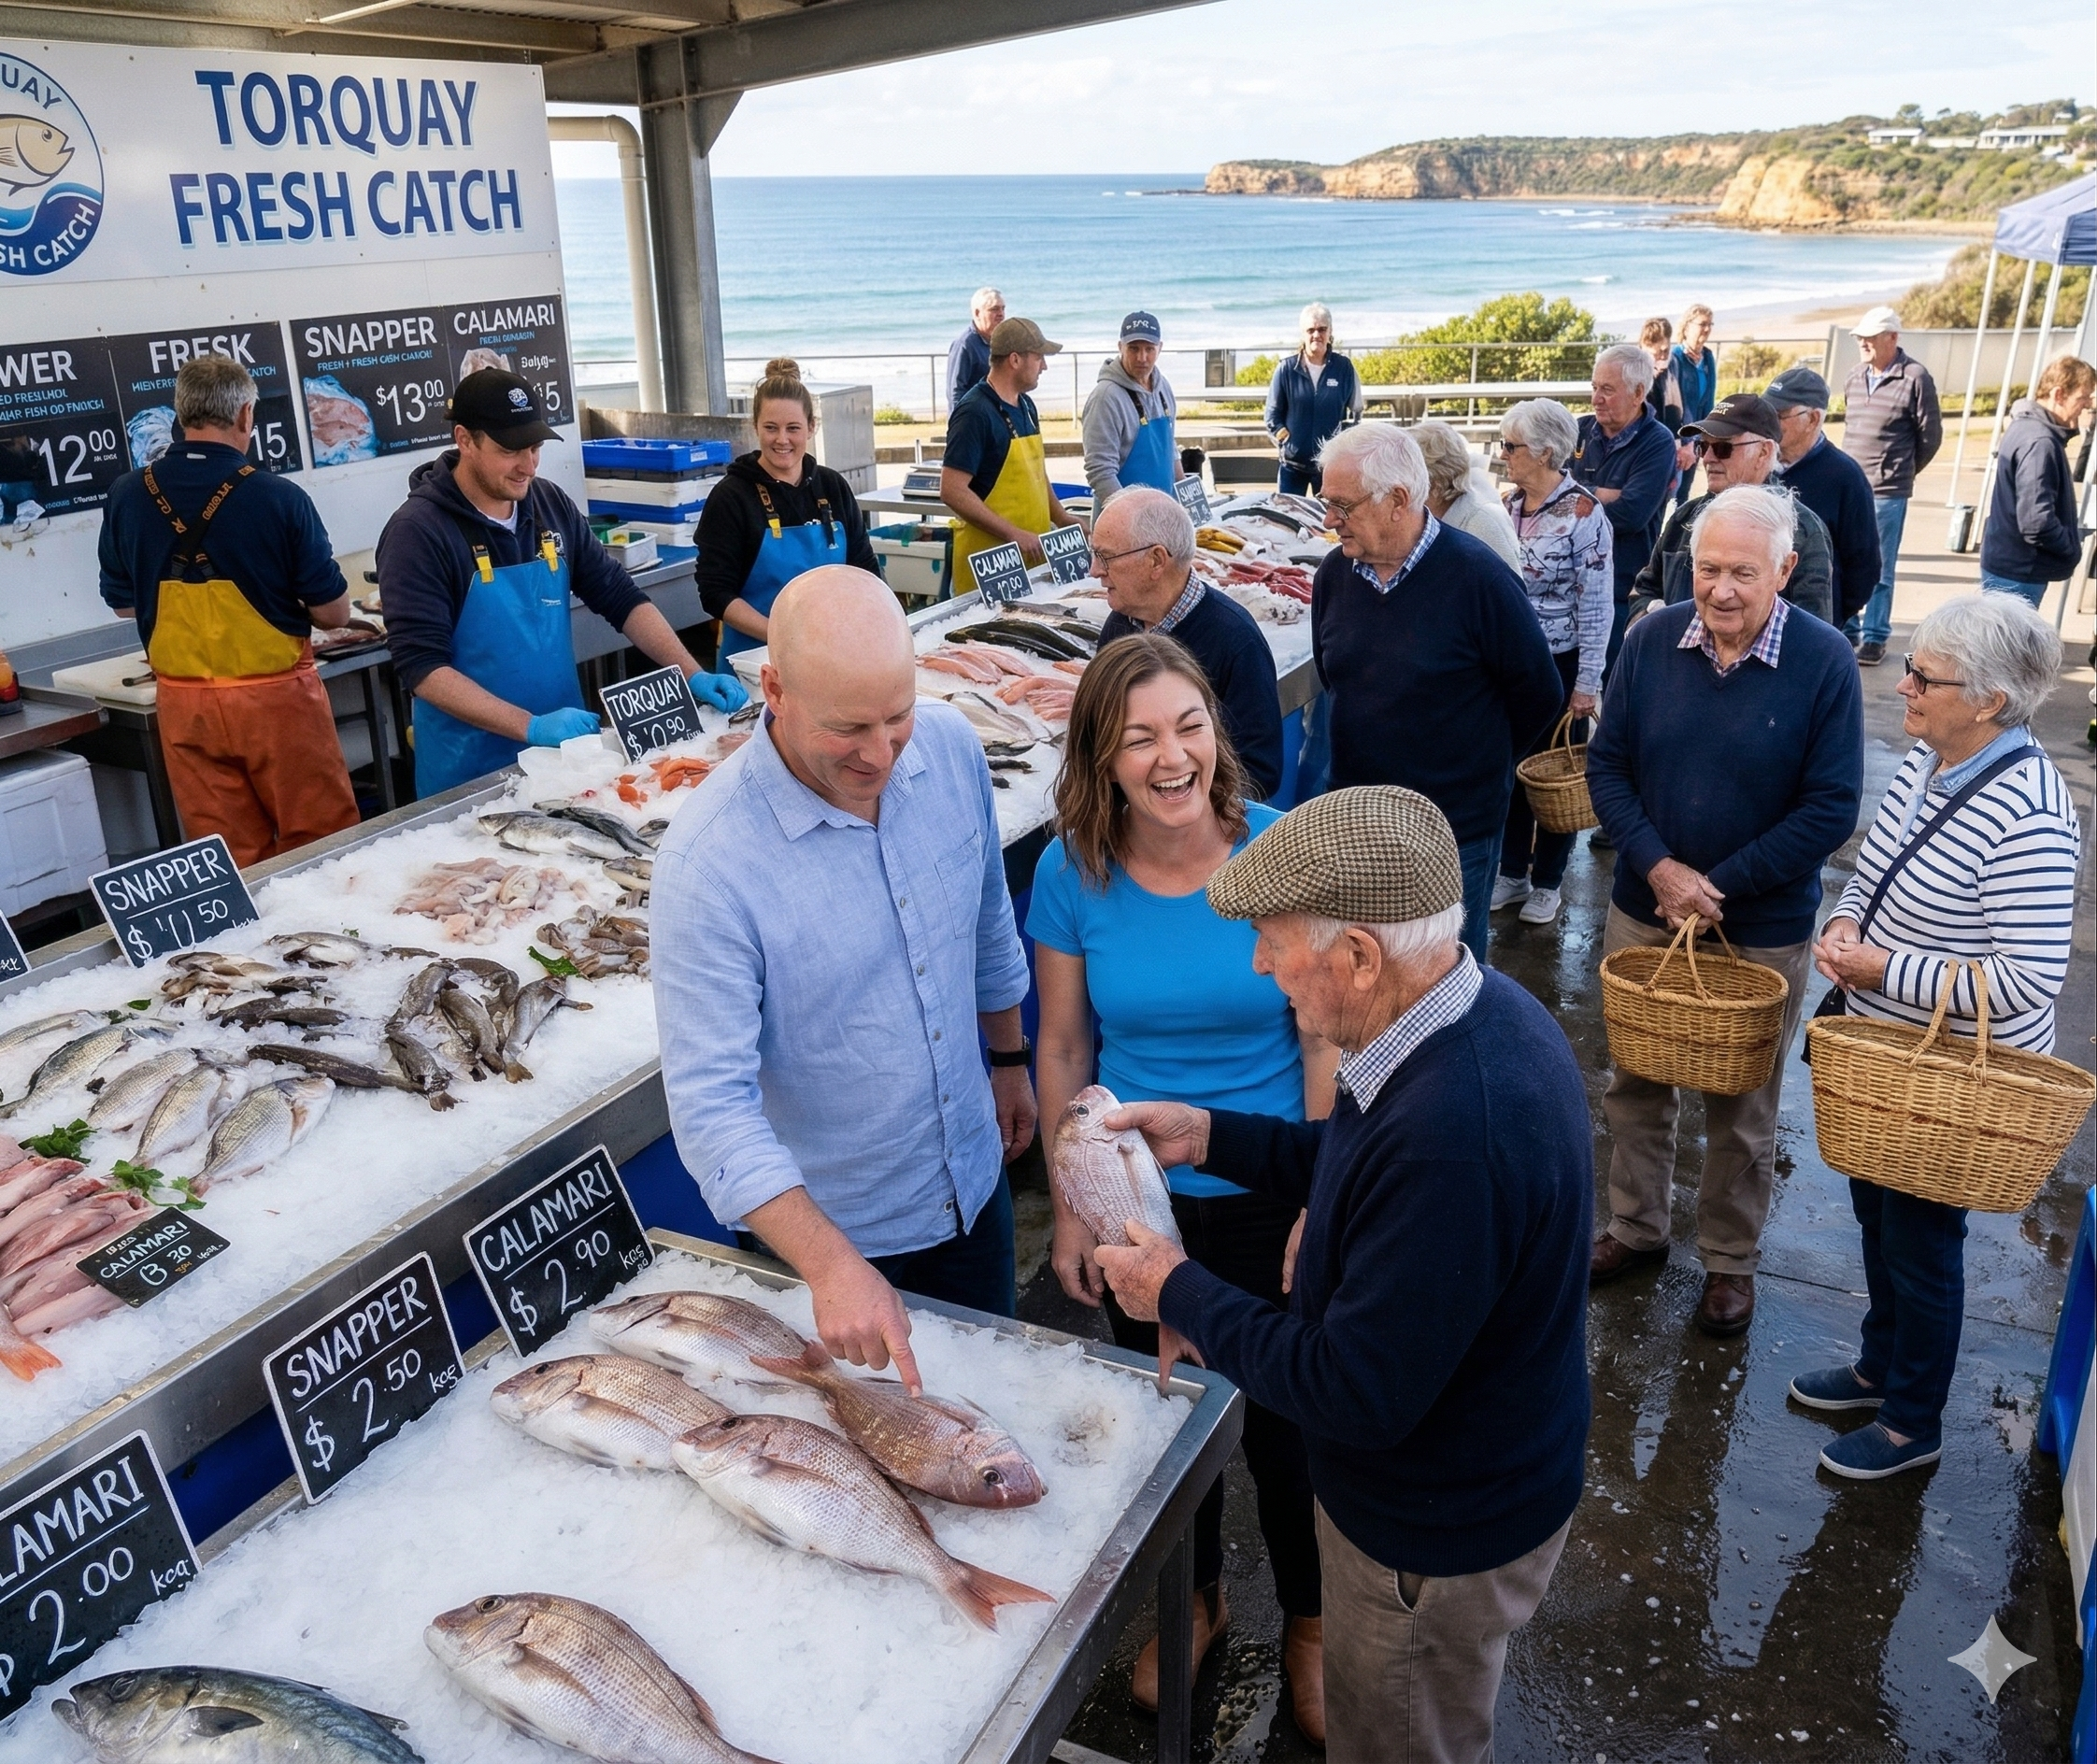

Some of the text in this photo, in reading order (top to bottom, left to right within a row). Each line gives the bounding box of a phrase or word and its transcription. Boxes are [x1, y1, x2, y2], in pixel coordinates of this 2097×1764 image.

[194, 70, 478, 154] TORQUAY
[33, 203, 95, 266] CATCH
[169, 169, 521, 245] FRESH CATCH
[305, 316, 438, 358] SNAPPER
[453, 303, 556, 335] CALAMARI
[606, 674, 683, 721] TORQUAY
[627, 731, 643, 760] $
[105, 847, 229, 911] SNAPPER
[127, 924, 153, 960] $
[480, 1161, 613, 1272] CALAMARI
[100, 1220, 188, 1279] CALAMARI
[286, 1276, 428, 1398] SNAPPER
[510, 1287, 537, 1337] $
[305, 1415, 335, 1472] $
